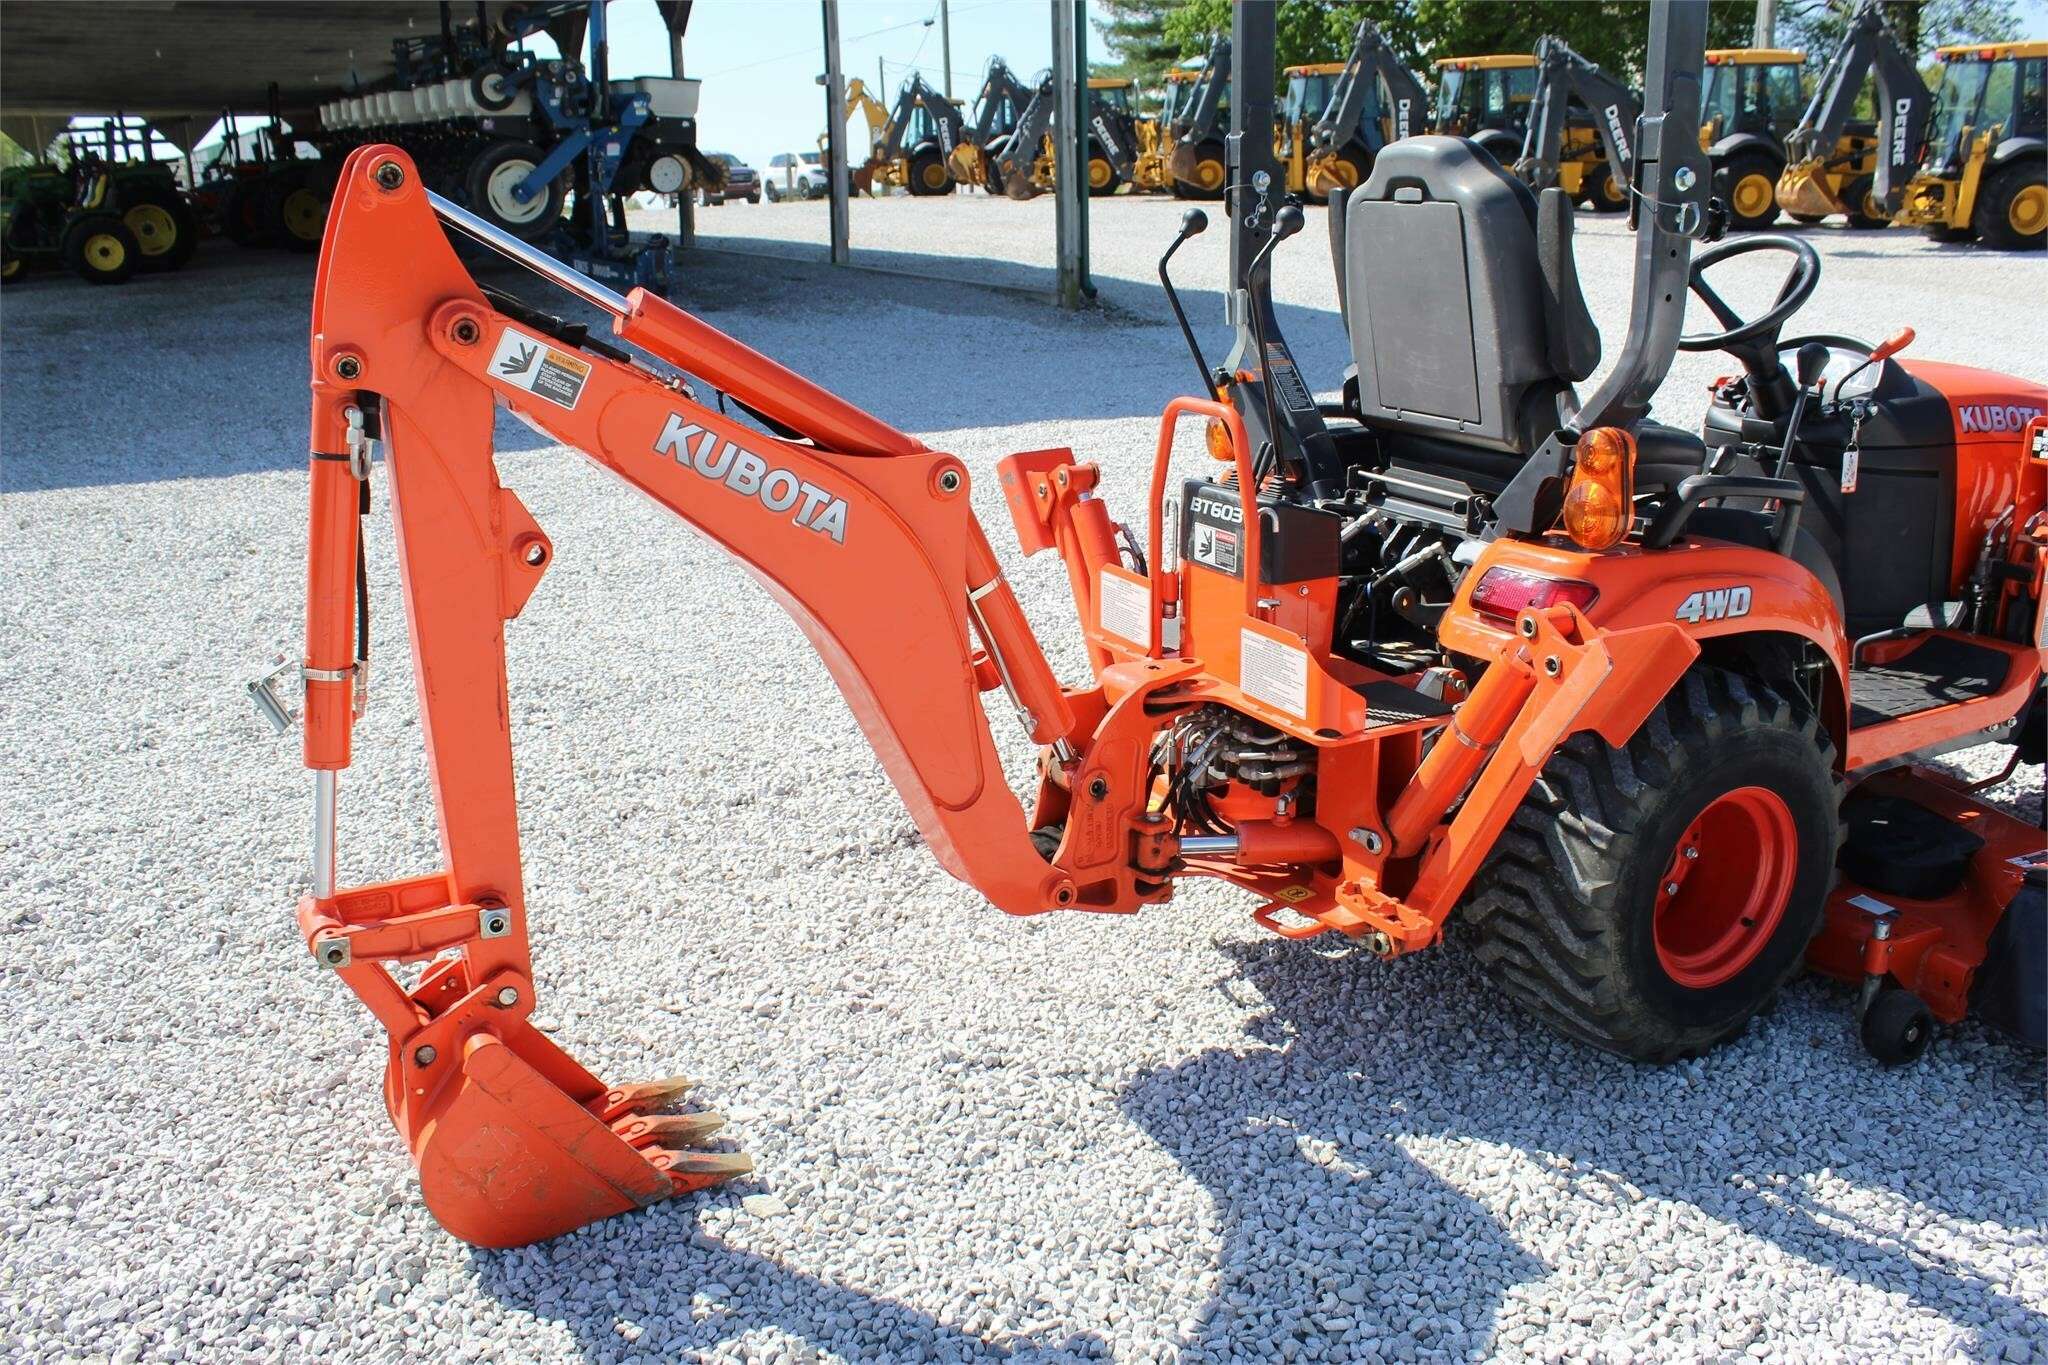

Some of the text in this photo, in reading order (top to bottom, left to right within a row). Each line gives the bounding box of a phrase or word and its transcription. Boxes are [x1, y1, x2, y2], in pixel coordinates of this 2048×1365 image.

[939, 117, 953, 153] DEERE
[1092, 115, 1120, 156] DEERE
[1399, 99, 1411, 140] DEER
[1605, 103, 1632, 162] DEERE
[1892, 98, 1912, 167] DEERE
[653, 411, 848, 544] KUBOTA
[1190, 496, 1244, 524] BT603
[1675, 585, 1752, 624] 4WD
